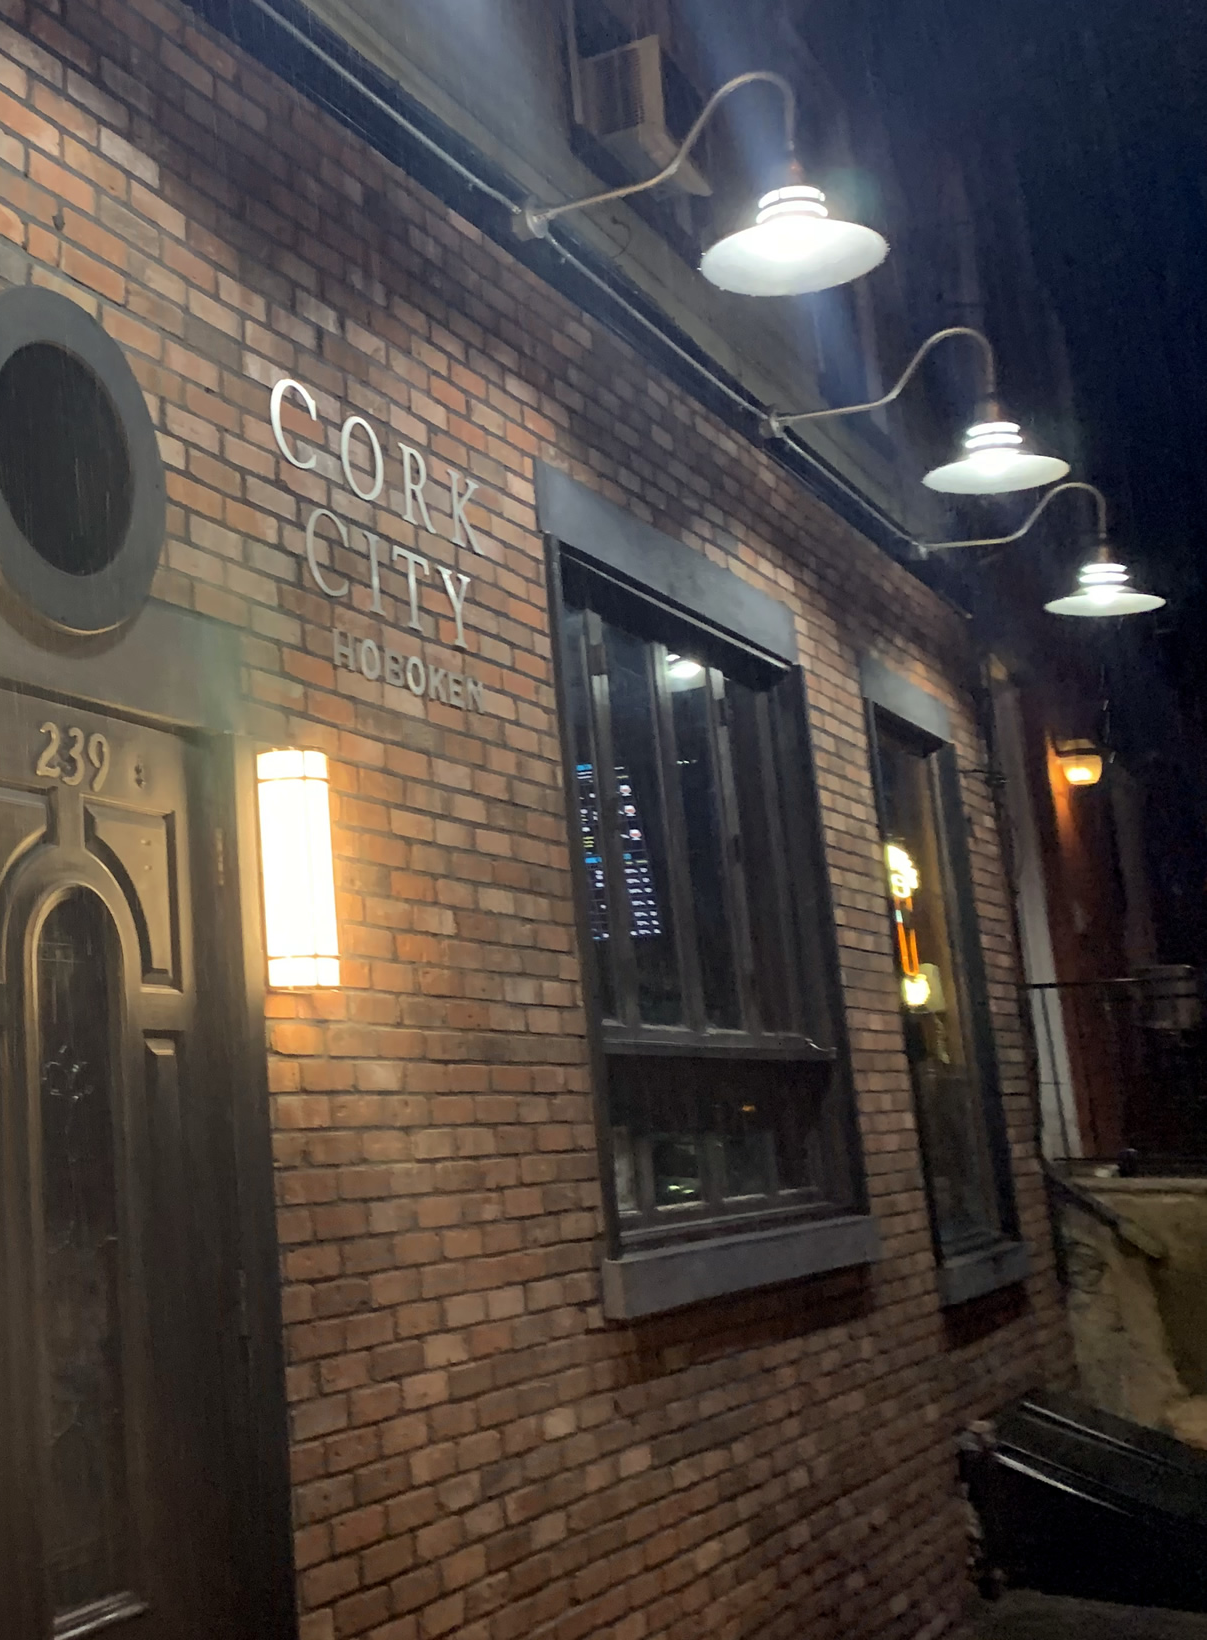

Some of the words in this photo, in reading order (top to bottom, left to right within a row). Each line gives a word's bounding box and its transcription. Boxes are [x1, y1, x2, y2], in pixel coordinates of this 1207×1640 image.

[270, 378, 484, 555] CORK
[306, 509, 471, 650] CITY
[332, 629, 485, 714] HOBOKEN
[36, 721, 111, 792] 239
